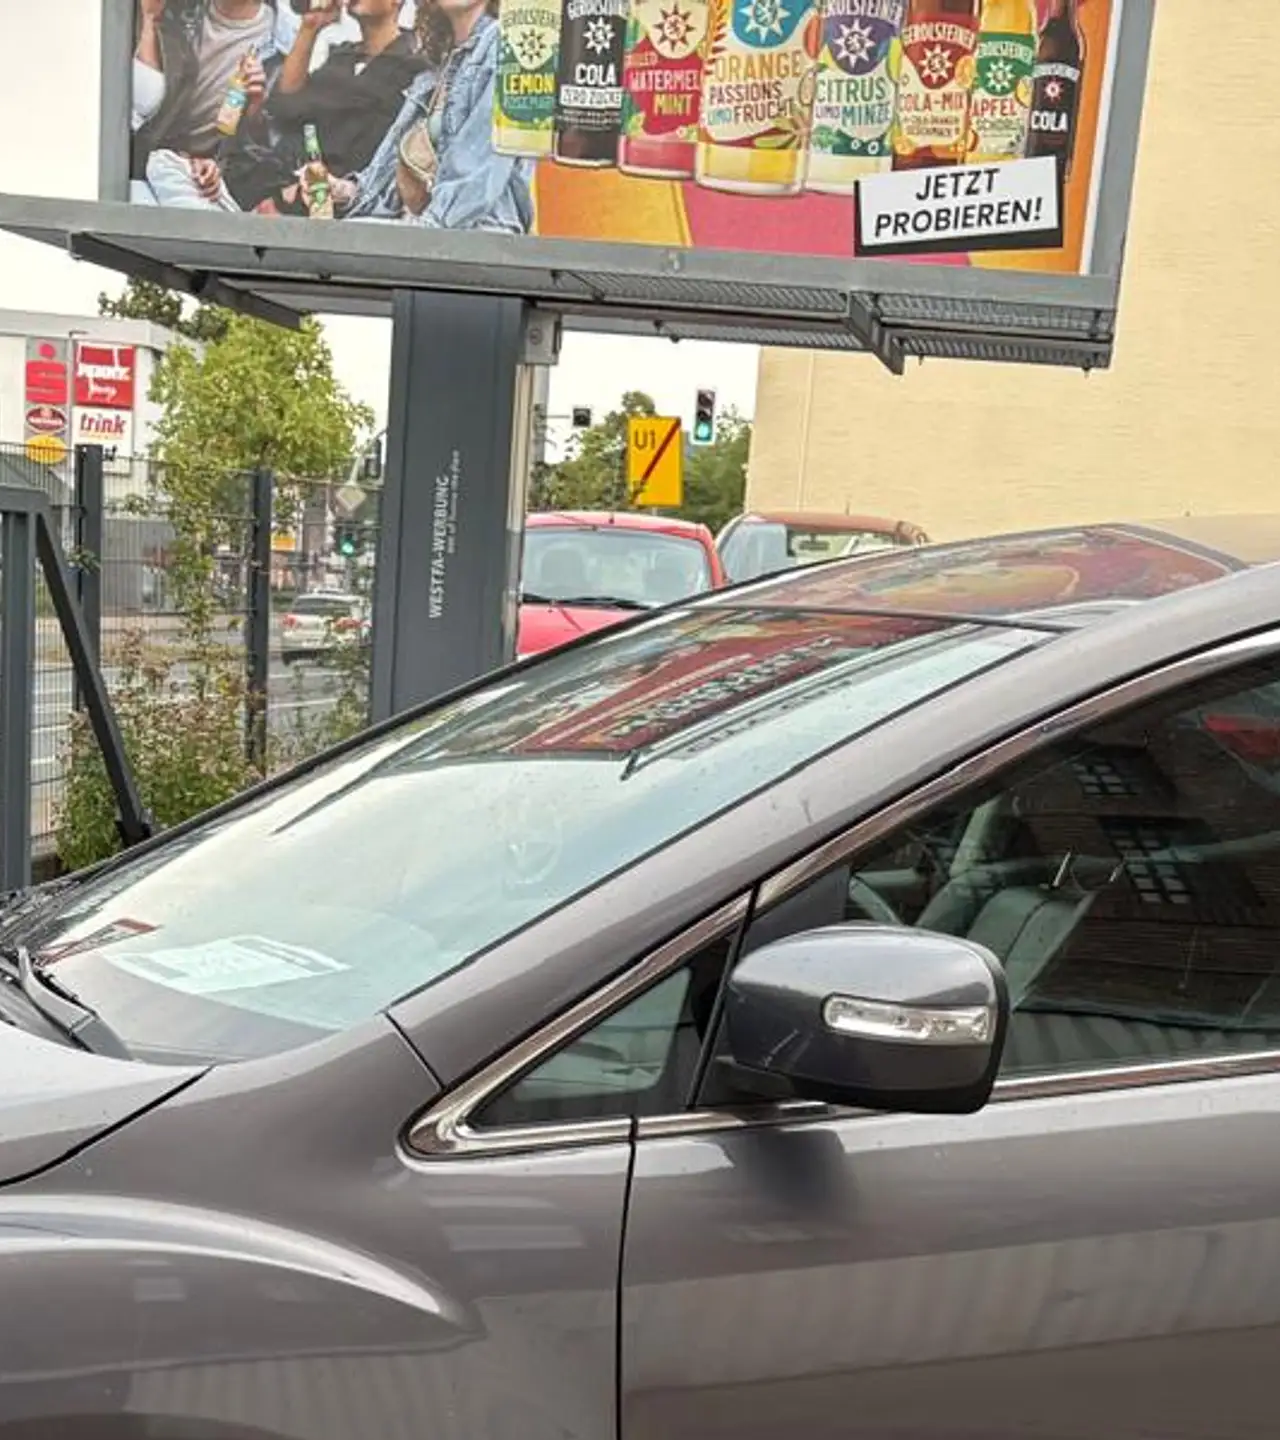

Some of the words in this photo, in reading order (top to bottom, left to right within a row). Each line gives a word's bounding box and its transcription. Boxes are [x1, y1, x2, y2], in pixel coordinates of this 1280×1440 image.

[574, 62, 617, 87] COLA
[715, 51, 802, 82] ORANGE
[503, 73, 556, 95] LEMON
[709, 80, 783, 105] PASSIONS
[816, 76, 887, 102] CITRUS
[653, 93, 693, 116] MINT
[970, 98, 1017, 117] APFEL
[1031, 110, 1068, 131] COLA
[915, 168, 1000, 201] JETZT
[874, 196, 1043, 238] PROBIEREN!
[80, 412, 127, 435] trink
[633, 429, 655, 451] U1
[428, 474, 450, 619] WESTFA-WERBUNG
